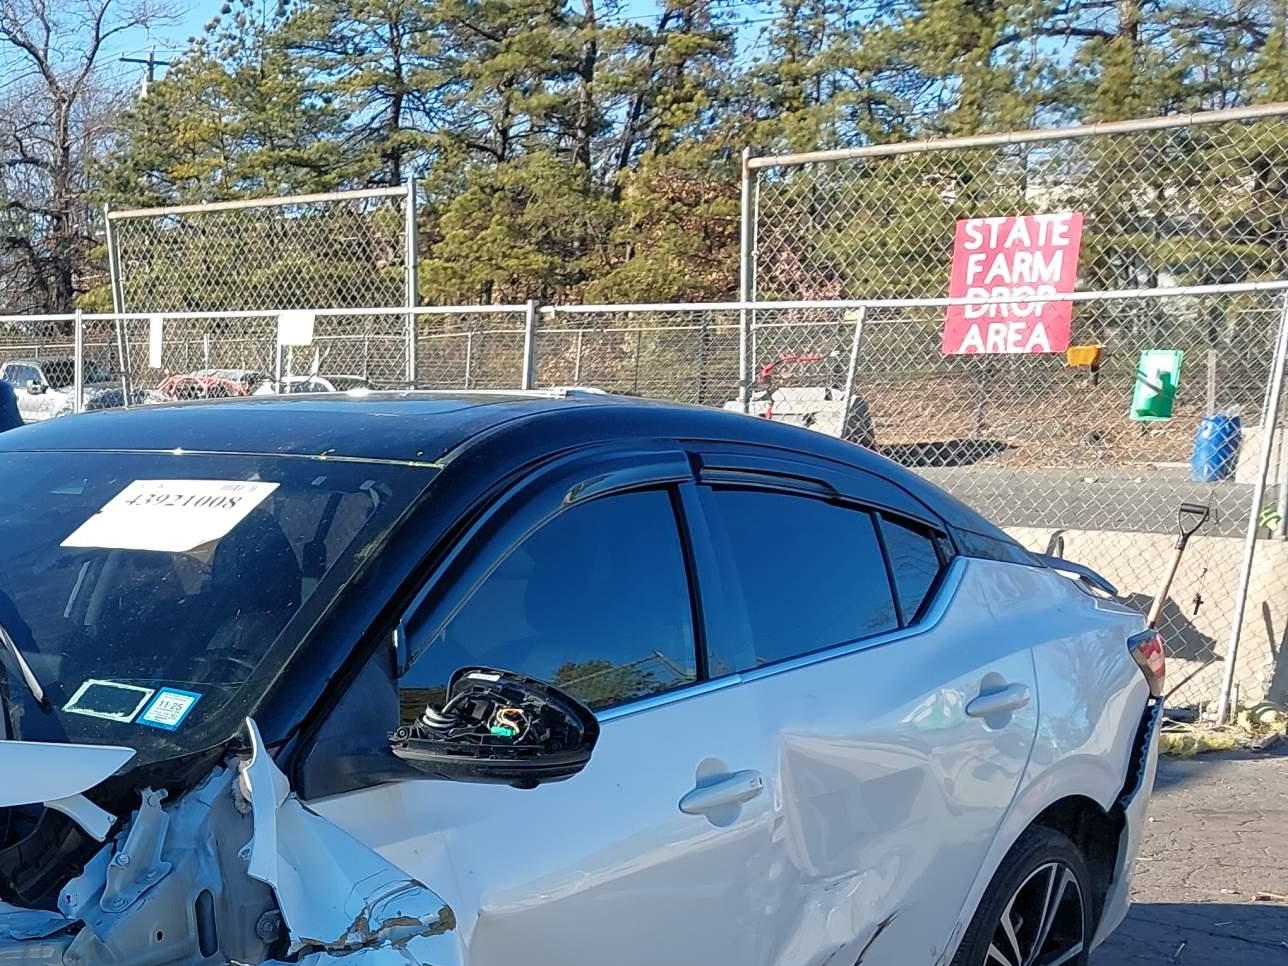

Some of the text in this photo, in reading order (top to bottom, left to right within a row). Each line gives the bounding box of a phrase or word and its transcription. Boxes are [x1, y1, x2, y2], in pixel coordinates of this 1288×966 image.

[963, 213, 1073, 250] STATE
[966, 250, 1064, 286] FARM
[963, 285, 1058, 319] DROP
[957, 321, 1051, 354] AREA
